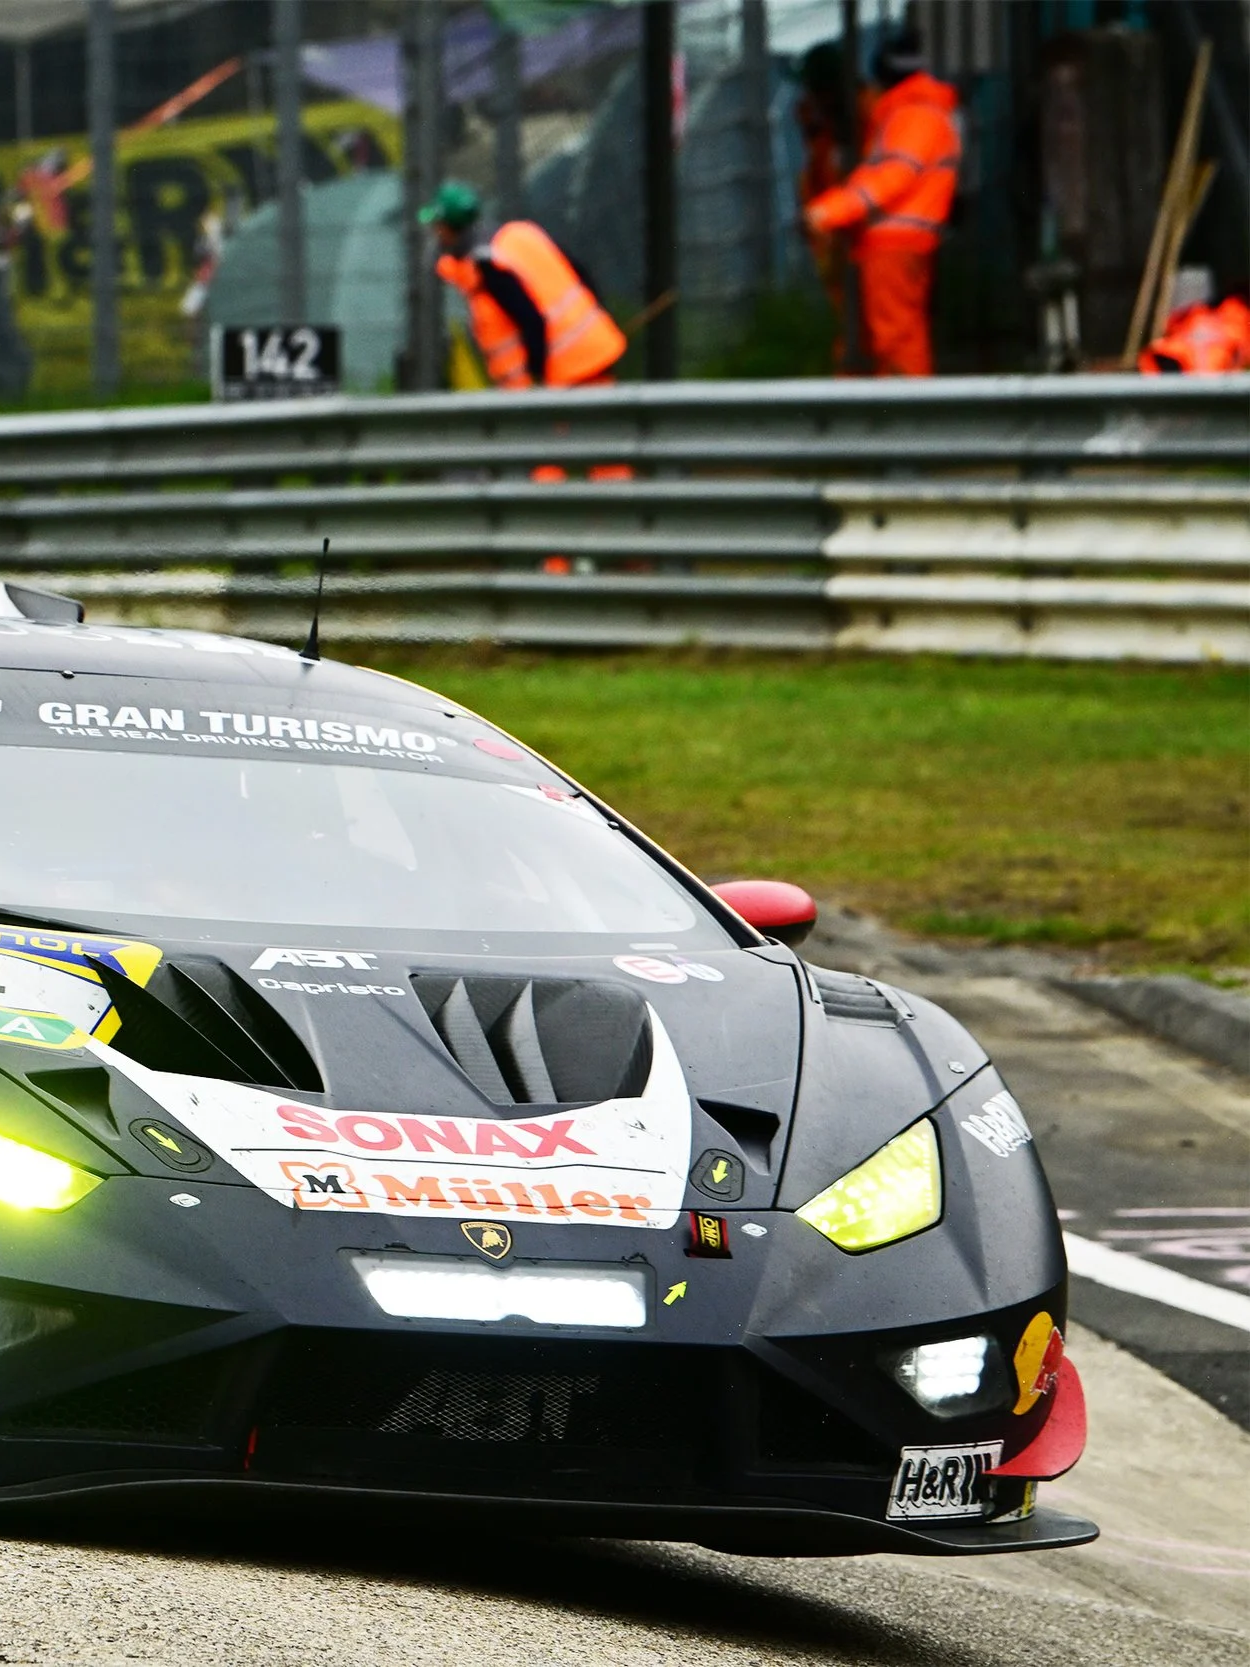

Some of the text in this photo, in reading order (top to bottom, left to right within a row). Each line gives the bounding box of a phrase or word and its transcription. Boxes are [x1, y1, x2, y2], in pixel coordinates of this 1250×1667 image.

[241, 328, 321, 380] 142
[38, 701, 185, 732] GRAN
[50, 726, 445, 764] THE REAL DRIVING SIMULATOR
[250, 948, 377, 971] ABT
[275, 1104, 598, 1158] SONAX
[372, 1173, 652, 1221] Müller
[702, 1217, 720, 1248] OMP
[378, 1370, 601, 1442] ABT
